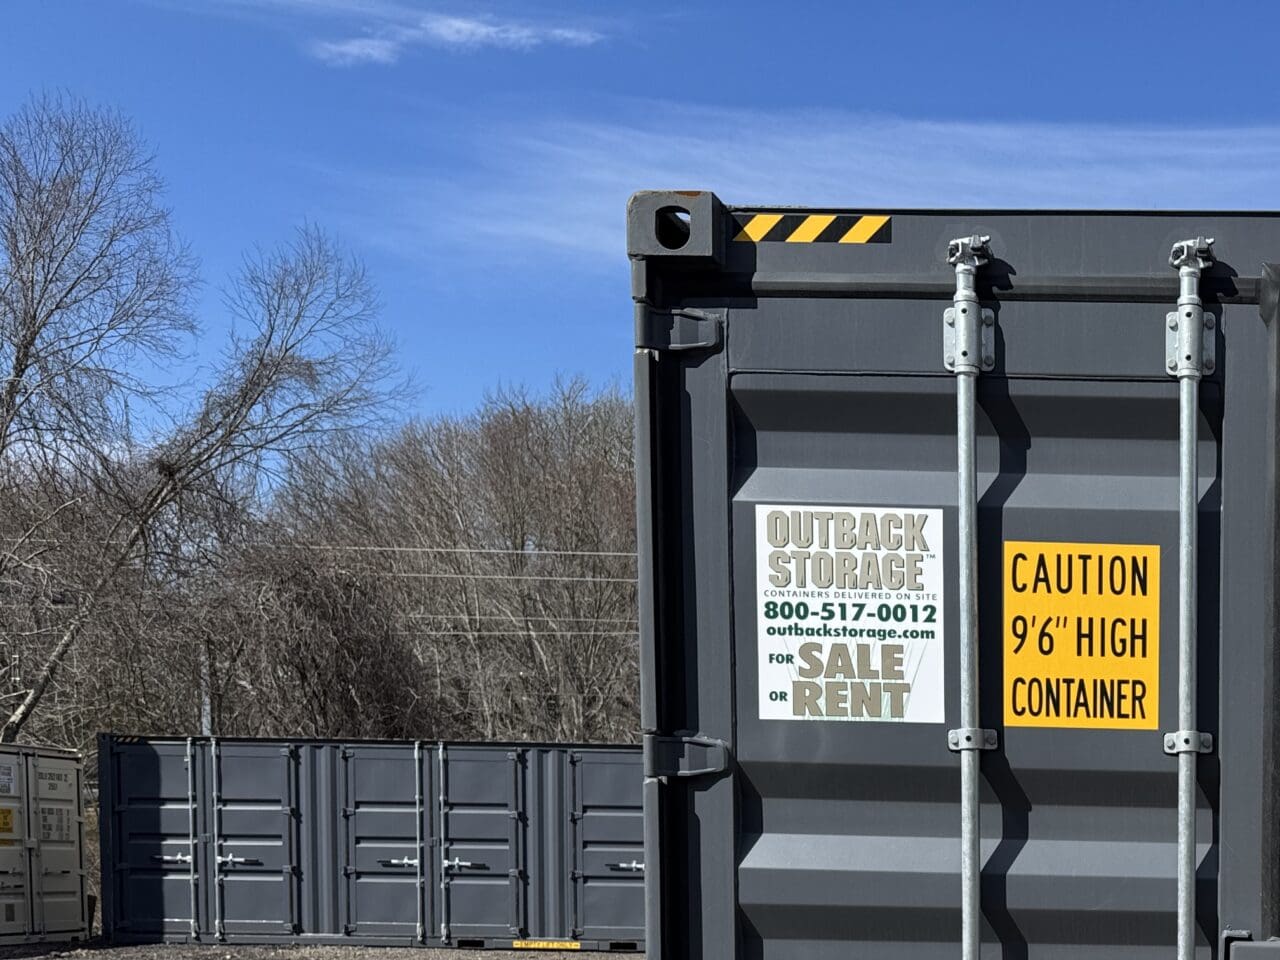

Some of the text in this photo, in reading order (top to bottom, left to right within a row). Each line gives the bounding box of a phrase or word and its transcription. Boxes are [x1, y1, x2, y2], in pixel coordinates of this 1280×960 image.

[766, 510, 930, 551] OUTBACK
[768, 550, 925, 591] STORAGE
[1011, 552, 1148, 596] CAUTION
[763, 589, 830, 599] CONTAINERS
[834, 591, 892, 600] DELIVERED
[916, 593, 937, 601] SITE
[764, 601, 936, 623] 800-517-0012
[766, 623, 935, 641] outbackstorage.com
[1011, 615, 1147, 658] 9'6" HIGH
[769, 642, 904, 680] FOR SALE
[769, 680, 911, 718] OR RENT
[1012, 677, 1146, 719] CONTAINER
